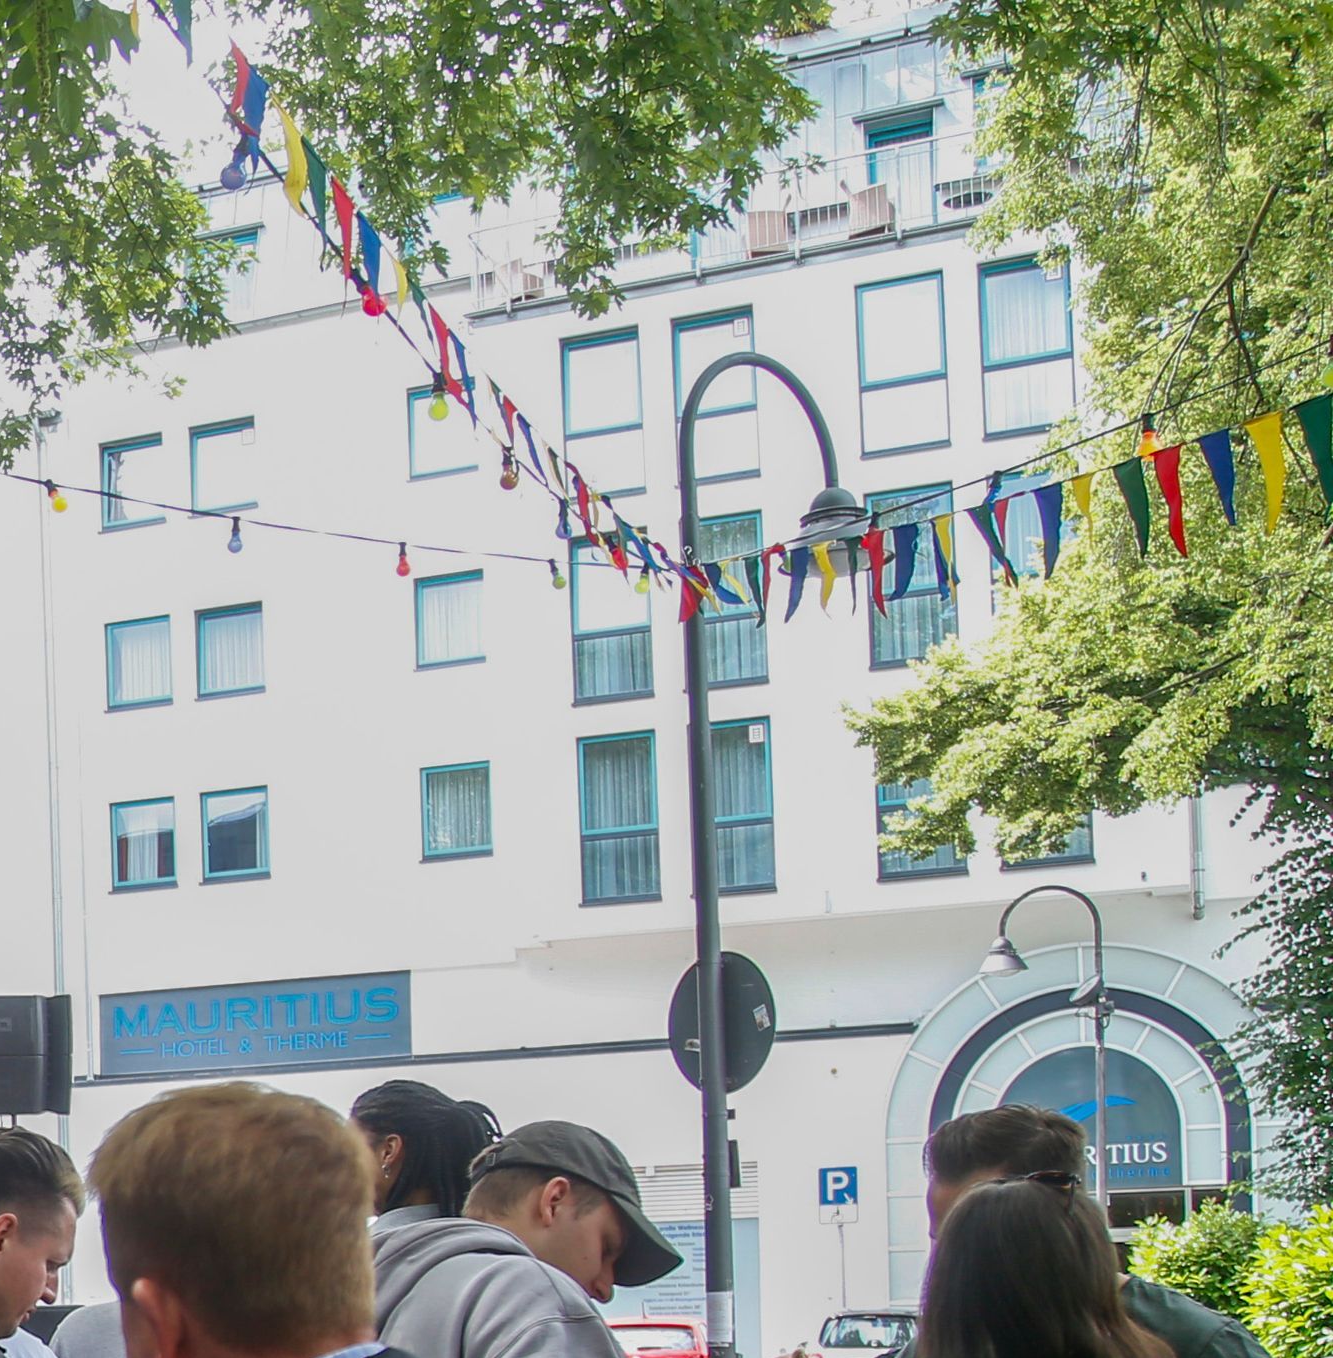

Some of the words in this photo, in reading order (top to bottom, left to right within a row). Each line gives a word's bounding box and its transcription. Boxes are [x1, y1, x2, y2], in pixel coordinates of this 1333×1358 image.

[113, 987, 400, 1039] MAURITIUS
[161, 1039, 229, 1058] HOTEL
[238, 1039, 252, 1054] &
[263, 1031, 349, 1051] THERME
[827, 1171, 849, 1201] P
